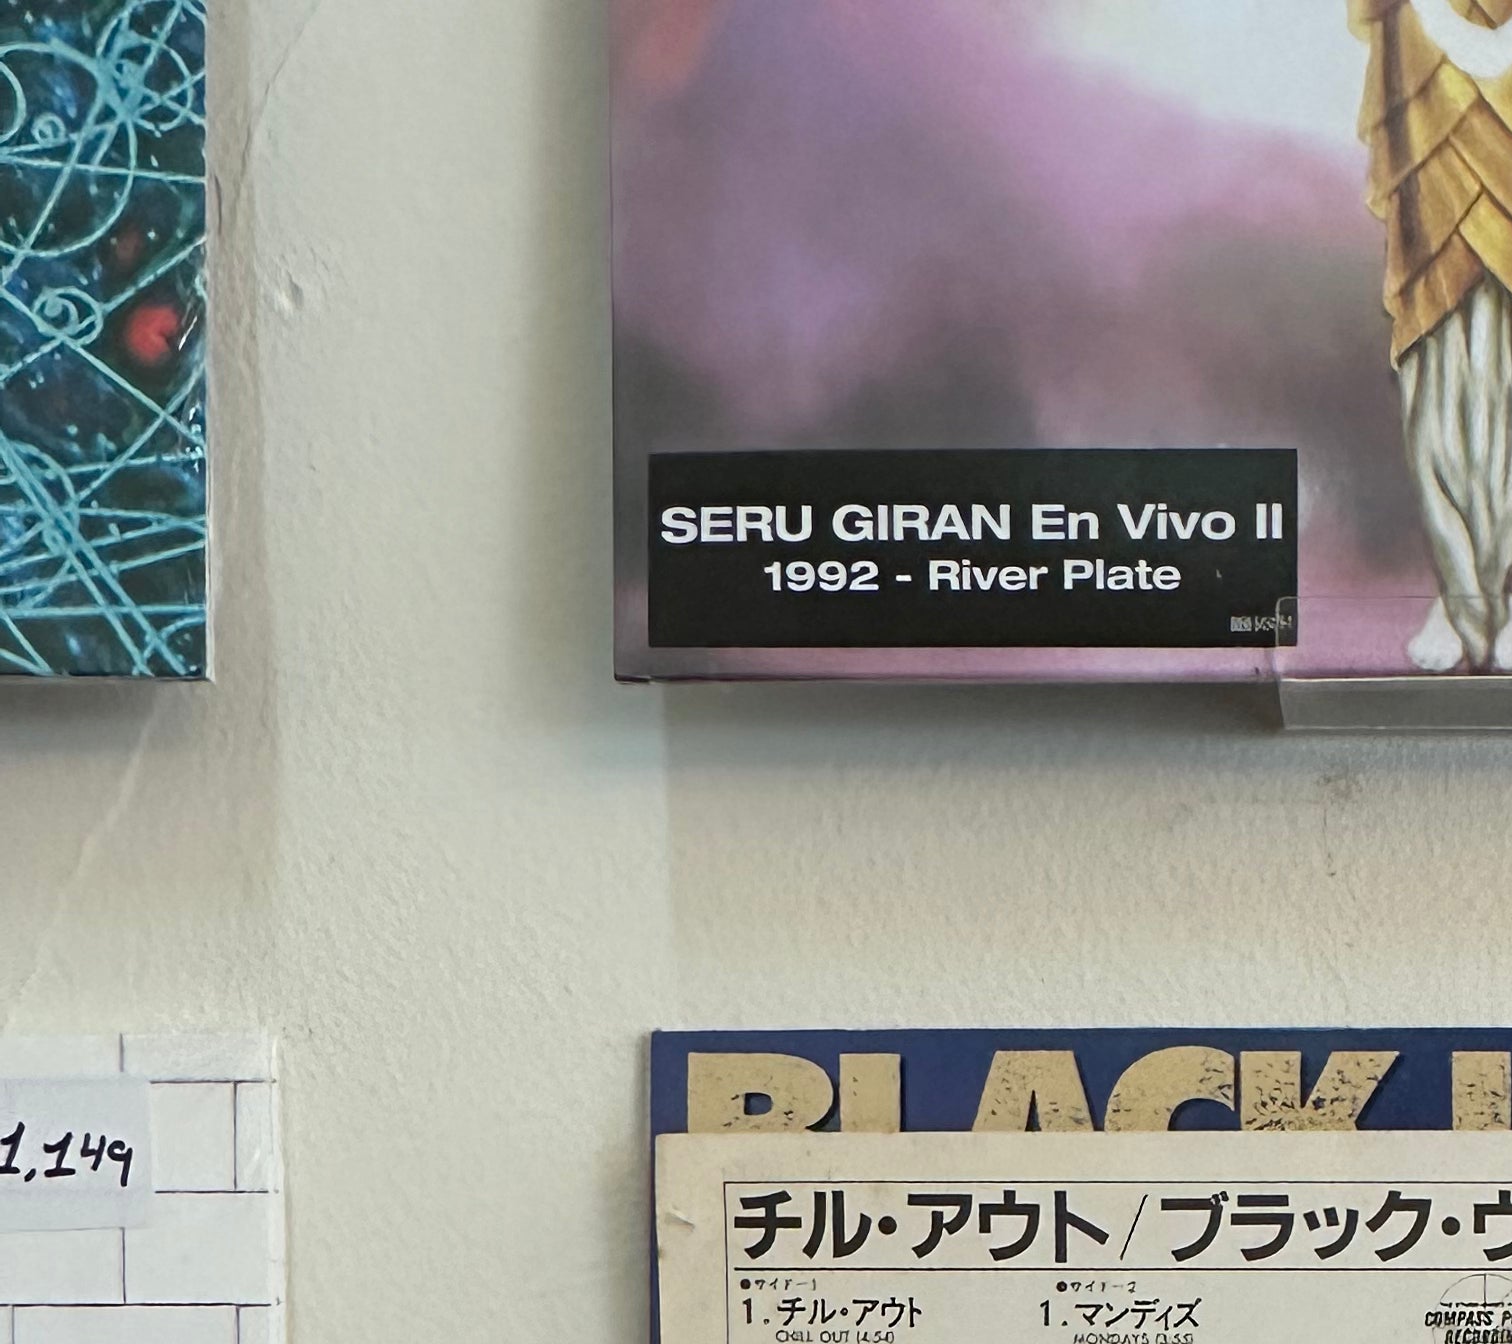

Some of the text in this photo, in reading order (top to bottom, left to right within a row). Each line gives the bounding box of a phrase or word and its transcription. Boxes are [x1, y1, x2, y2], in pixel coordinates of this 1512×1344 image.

[660, 503, 1283, 544] SERU GIRAN En Vivo II
[763, 561, 879, 592] 1992
[929, 559, 1055, 591] River
[1064, 558, 1182, 591] Plate
[777, 1297, 922, 1327] チル・アウト
[1074, 1297, 1202, 1330] マンディズ
[1424, 1310, 1494, 1327] COMPASS
[820, 1331, 850, 1343] OUT
[1073, 1332, 1150, 1344] MONDAYS
